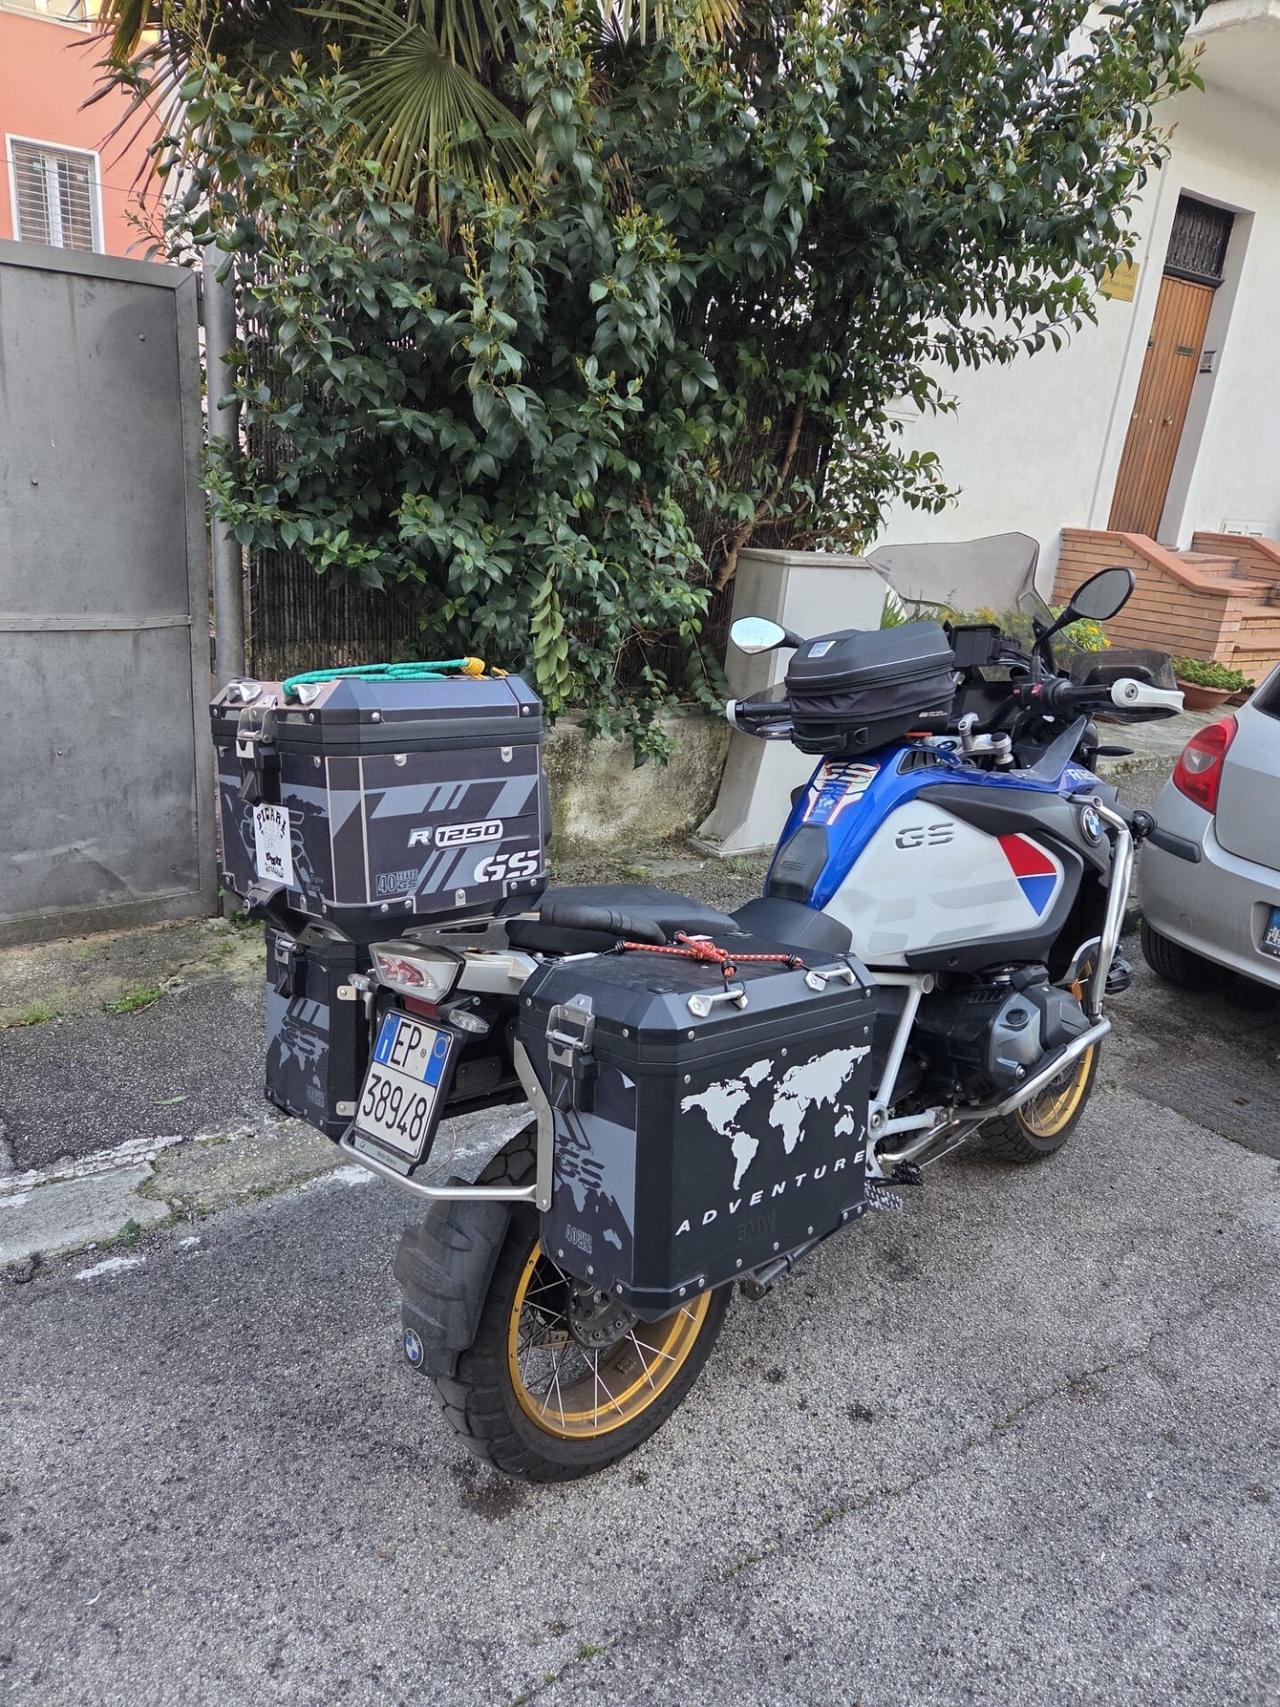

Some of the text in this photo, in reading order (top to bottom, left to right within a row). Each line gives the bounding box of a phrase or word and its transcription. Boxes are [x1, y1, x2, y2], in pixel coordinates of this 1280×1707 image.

[408, 822, 501, 848] R 1250
[895, 823, 955, 850] GS
[473, 850, 541, 883] GS
[390, 1021, 422, 1067] EP
[363, 1073, 427, 1142] 38948
[675, 1150, 866, 1236] ADVENTURE
